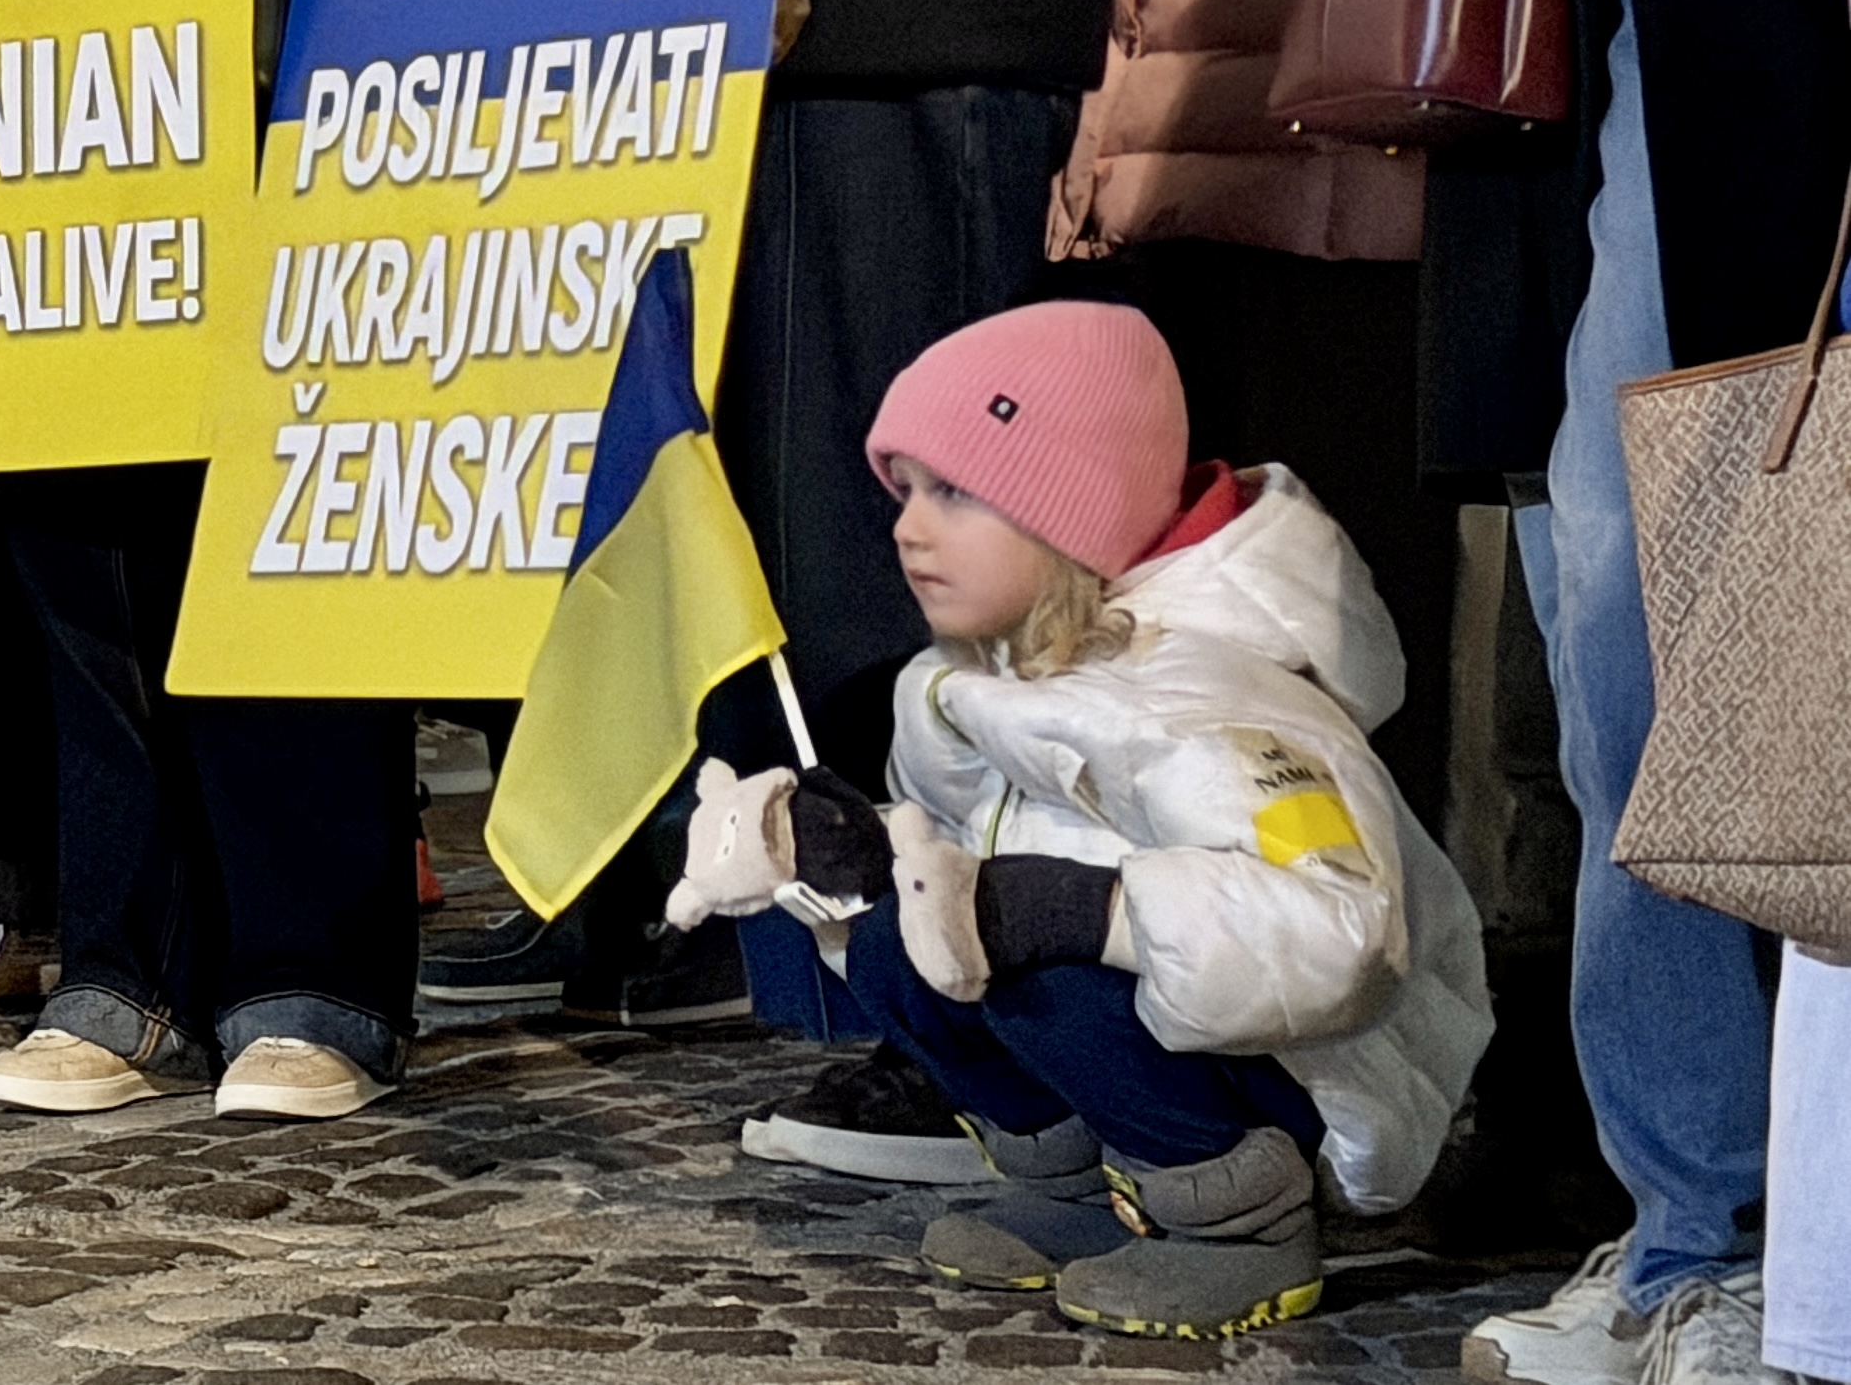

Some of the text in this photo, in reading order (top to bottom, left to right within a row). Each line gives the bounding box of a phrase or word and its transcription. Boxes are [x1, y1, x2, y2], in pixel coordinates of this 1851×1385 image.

[296, 22, 727, 197] POSILJEVATI
[264, 213, 703, 382] UKRAJINSK
[250, 382, 602, 575] ŽENSKE
